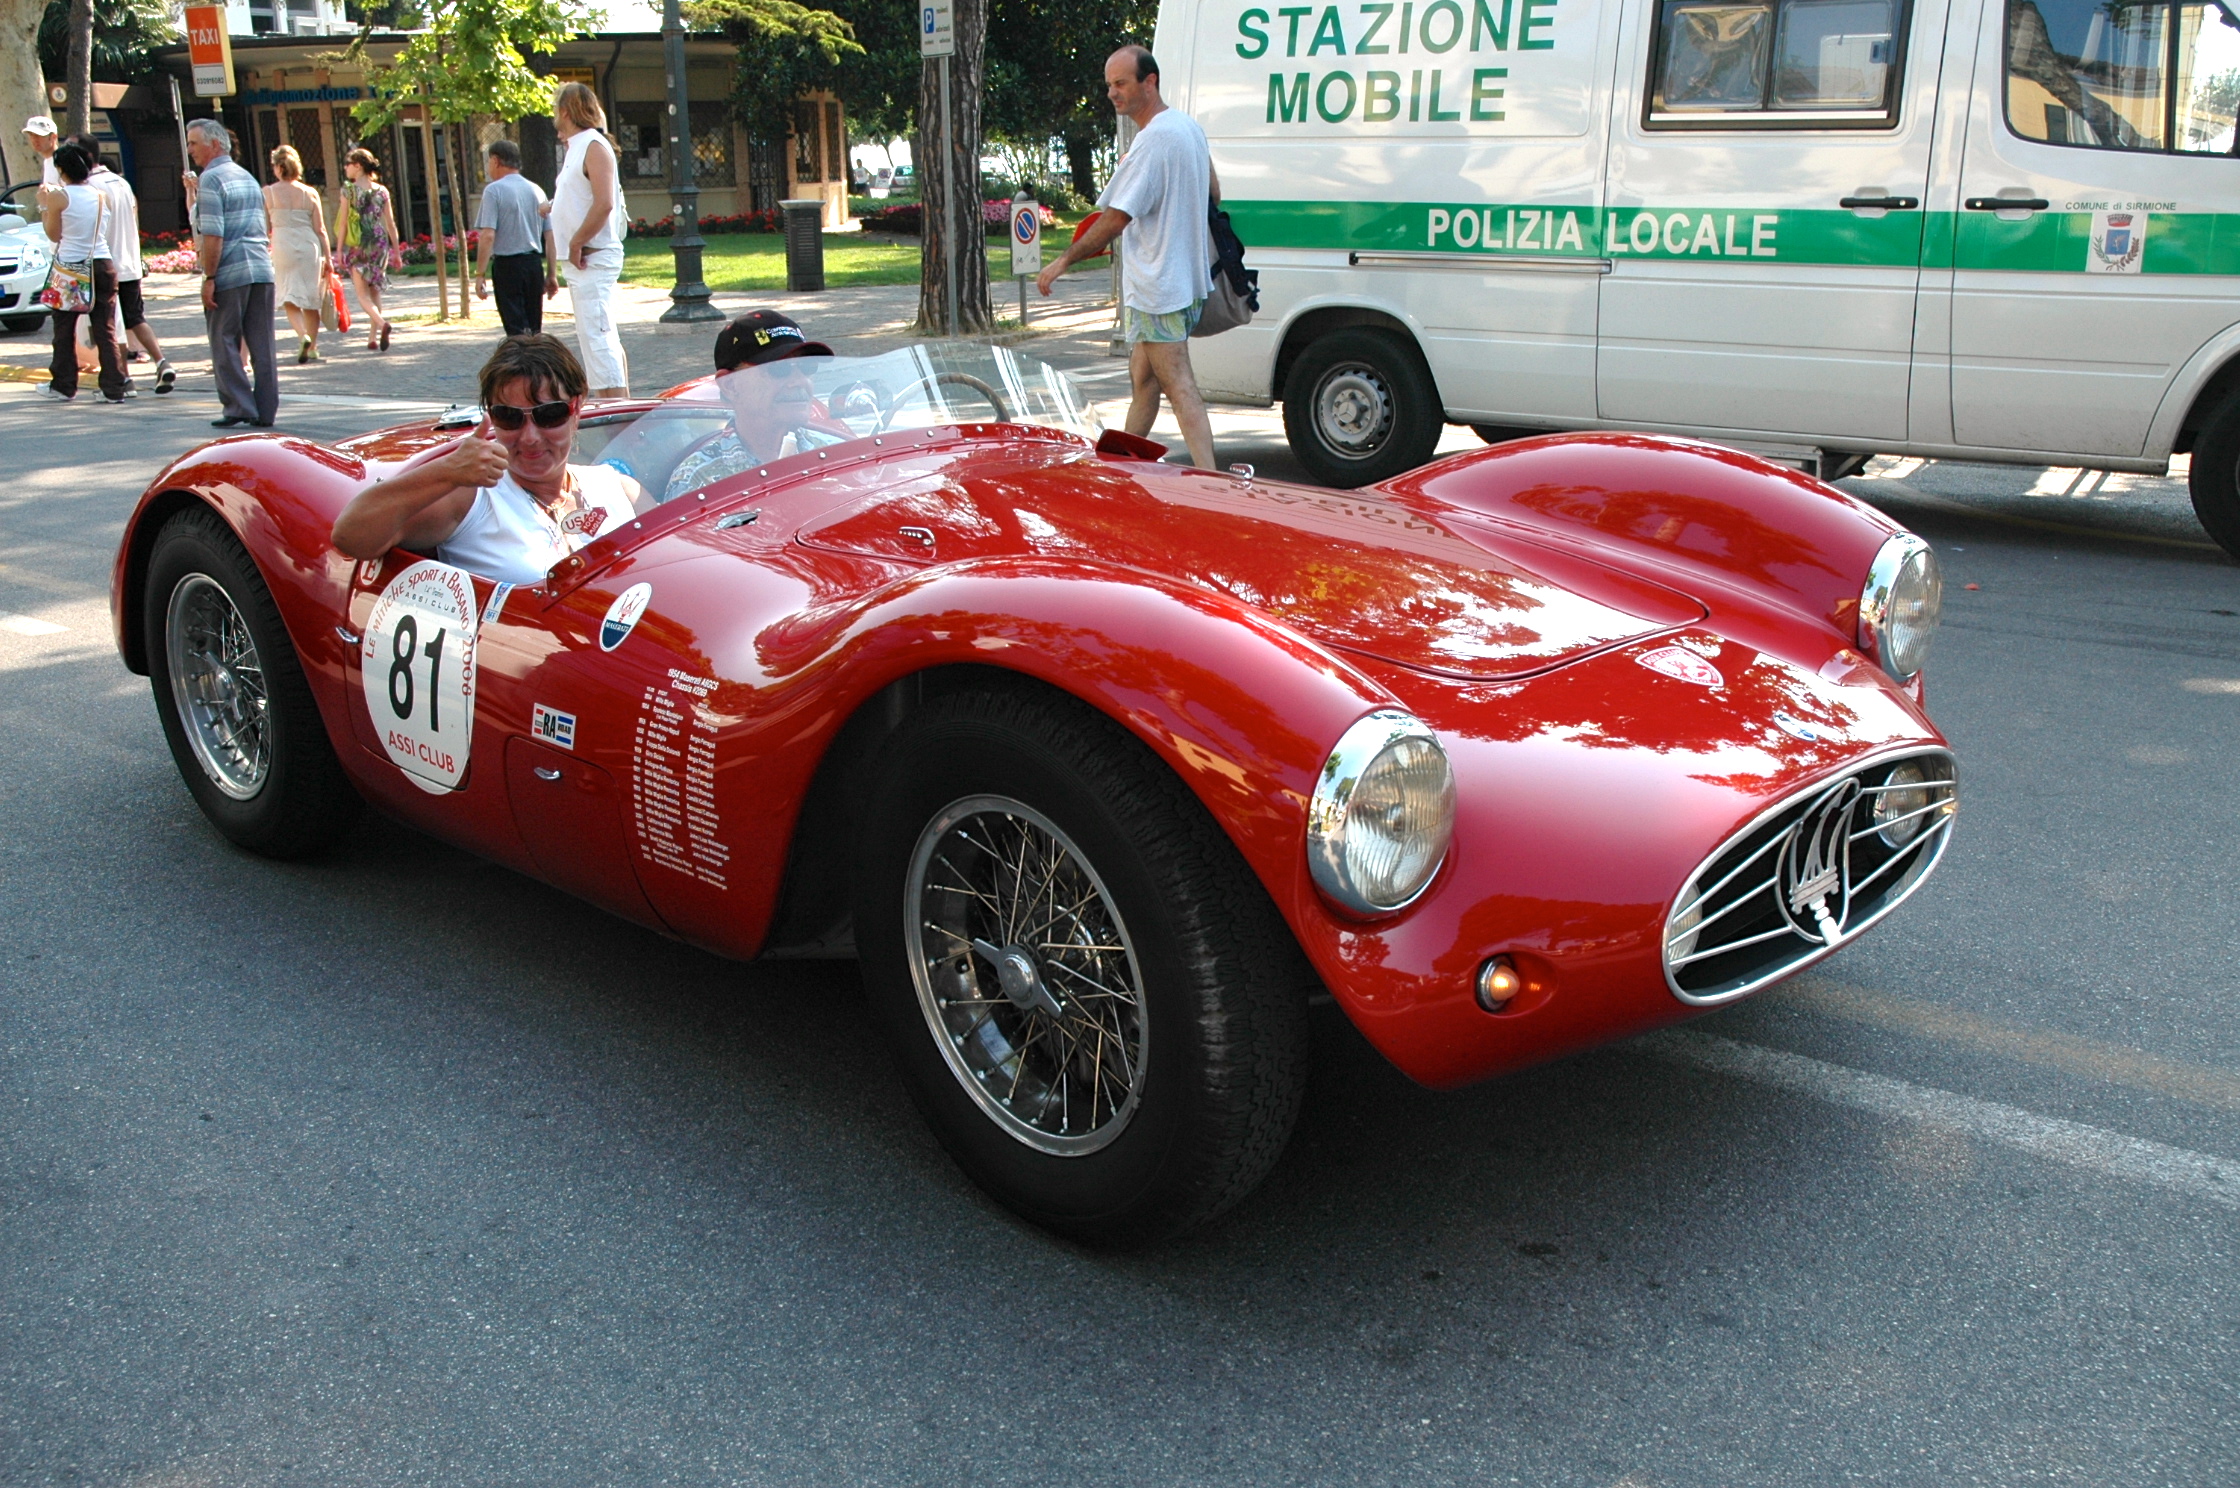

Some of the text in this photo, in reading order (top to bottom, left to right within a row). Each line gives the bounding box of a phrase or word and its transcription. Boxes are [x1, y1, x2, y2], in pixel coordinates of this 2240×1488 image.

[190, 28, 219, 46] TAXI
[1235, 0, 1557, 59] STAZIONE
[1266, 68, 1508, 123] MOBILE
[2065, 202, 2176, 211] COMUNE di SIRMIONE
[1428, 209, 1778, 256] POLIZIA LOCALE
[582, 511, 598, 530] 1000
[365, 637, 376, 658] LE
[408, 569, 440, 590] SPORT
[438, 572, 448, 584] A
[446, 572, 470, 630] BASSANO
[605, 621, 630, 632] MASERATI
[388, 614, 446, 733] 81
[668, 668, 680, 678] 1954
[680, 672, 702, 685] Maserati
[672, 680, 692, 693] Chassis
[543, 712, 556, 738] RA
[388, 730, 454, 774] ASSI CLUB
